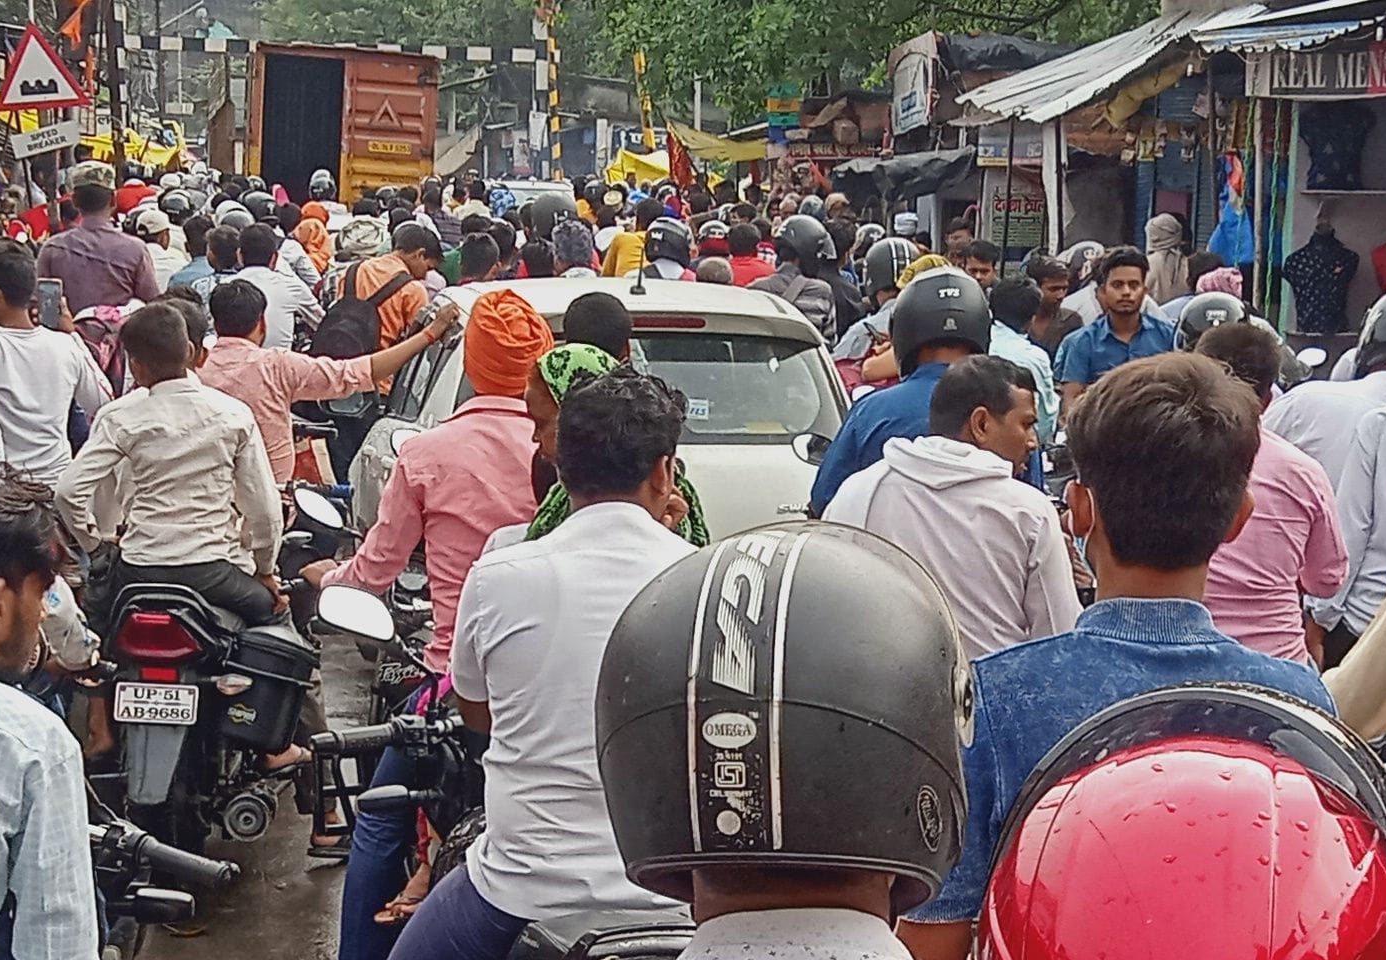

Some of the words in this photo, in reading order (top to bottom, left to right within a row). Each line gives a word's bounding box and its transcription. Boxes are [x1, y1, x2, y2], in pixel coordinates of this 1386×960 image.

[1272, 50, 1327, 89] REAL
[30, 128, 58, 142] SPEED
[26, 135, 68, 152] BREAKER
[938, 287, 961, 299] TVS
[133, 687, 157, 700] UP
[705, 722, 752, 737] OMEGA
